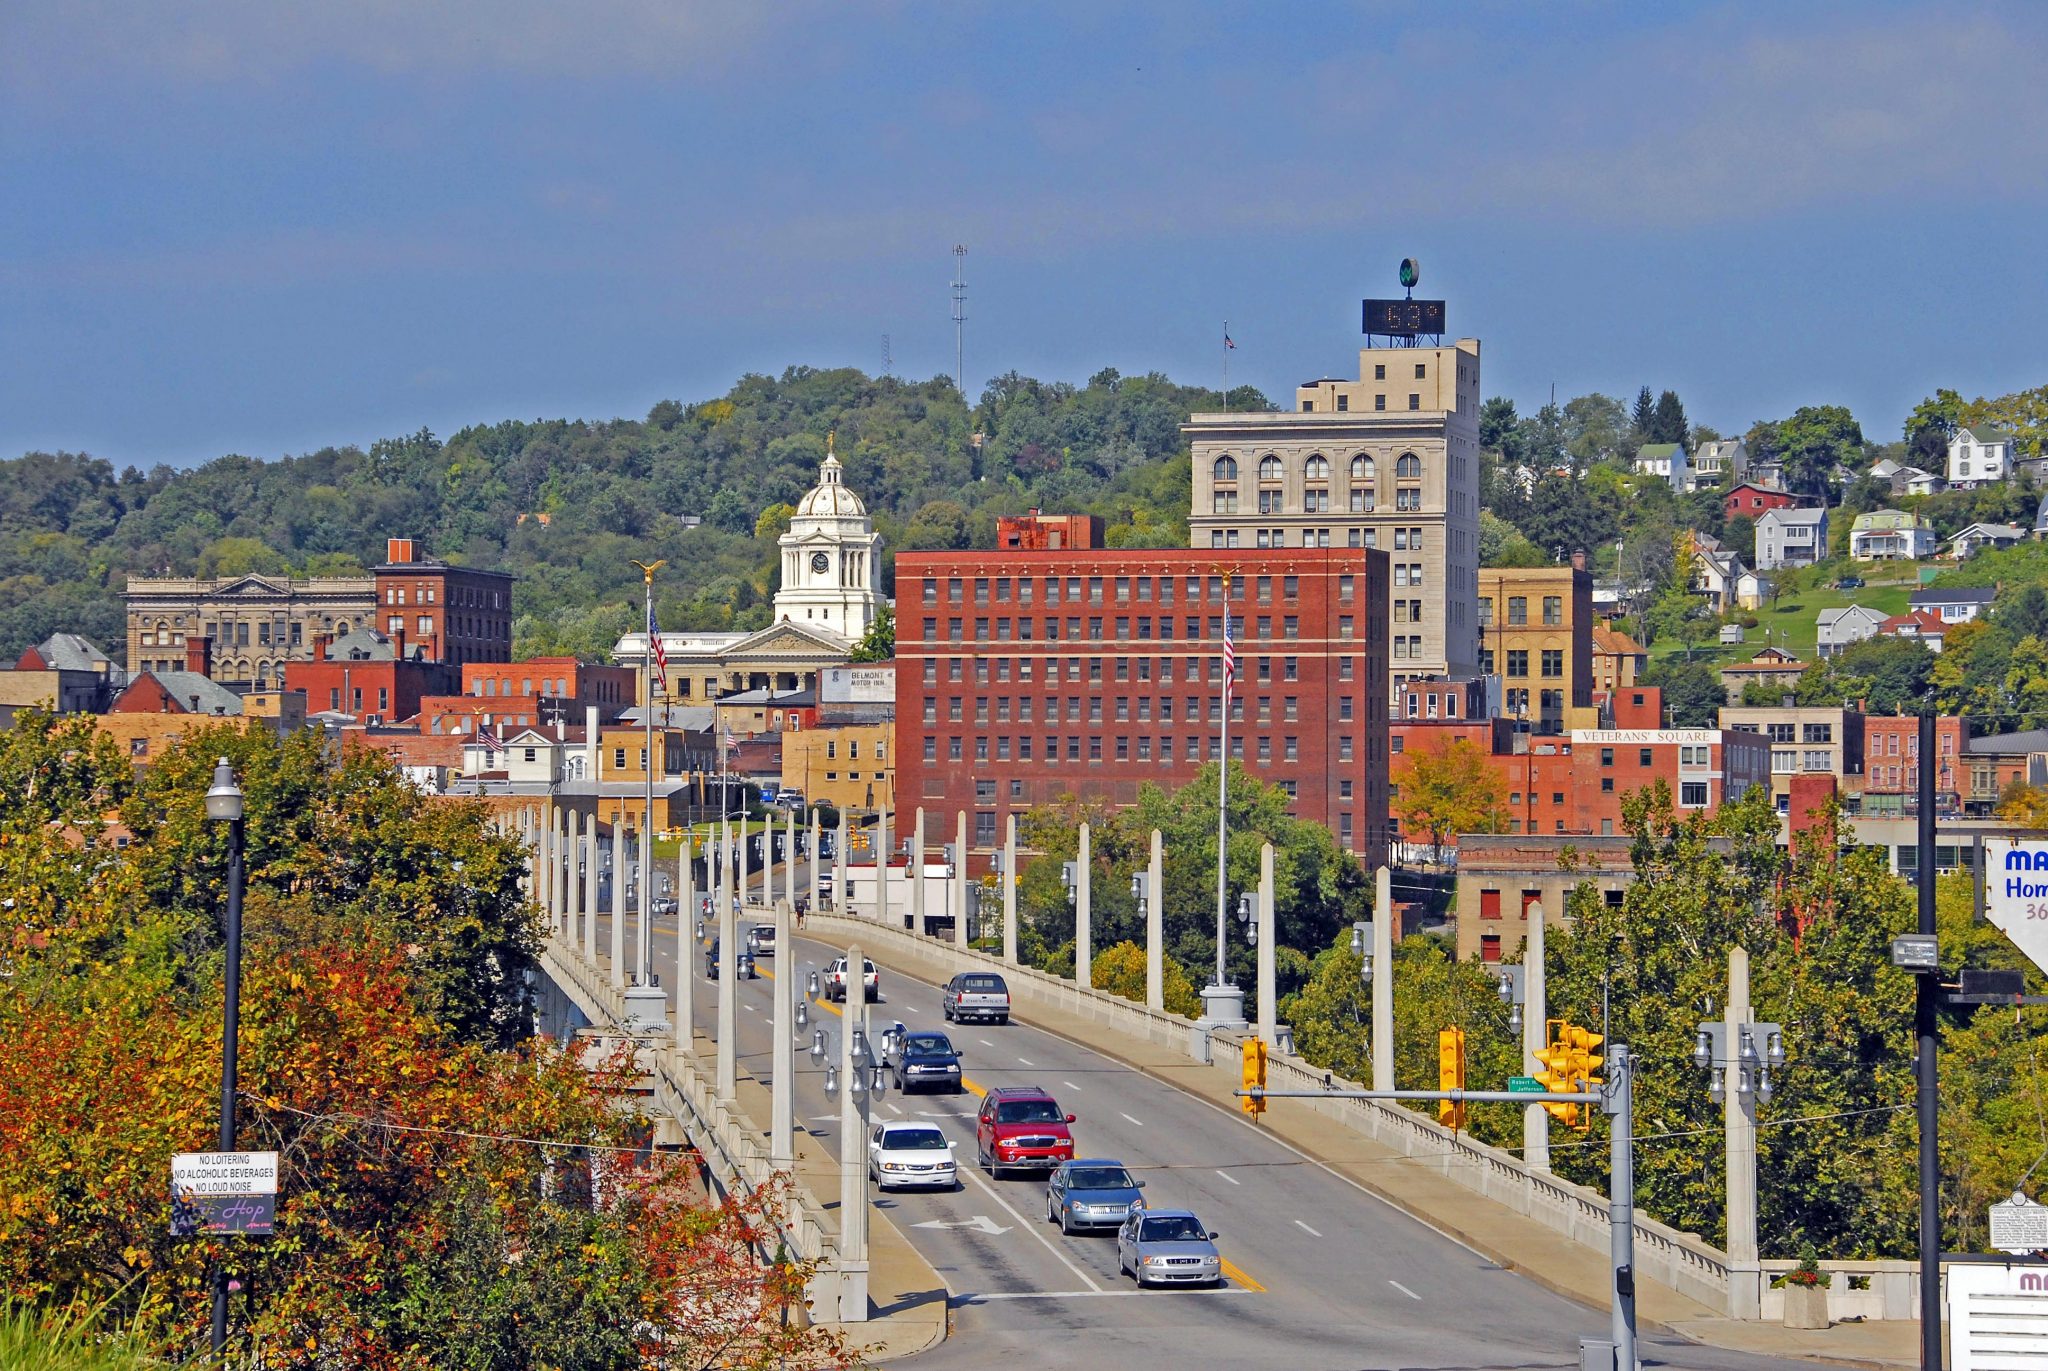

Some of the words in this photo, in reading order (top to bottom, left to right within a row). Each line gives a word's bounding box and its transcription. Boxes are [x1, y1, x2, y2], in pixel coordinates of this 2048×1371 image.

[1583, 731, 1650, 742] VETERANS'
[1657, 731, 1710, 743] SQUARE
[199, 1155, 210, 1165] NO
[211, 1154, 250, 1165] LOITERING
[174, 1169, 185, 1179] NO
[187, 1168, 228, 1179] ALCOHOLIC
[230, 1167, 274, 1178] BEVERAGES
[196, 1182, 207, 1192] NO
[208, 1182, 228, 1192] LOUD
[229, 1181, 252, 1192] NOISE
[222, 1199, 265, 1222] Hop
[2020, 1273, 2048, 1291] M
